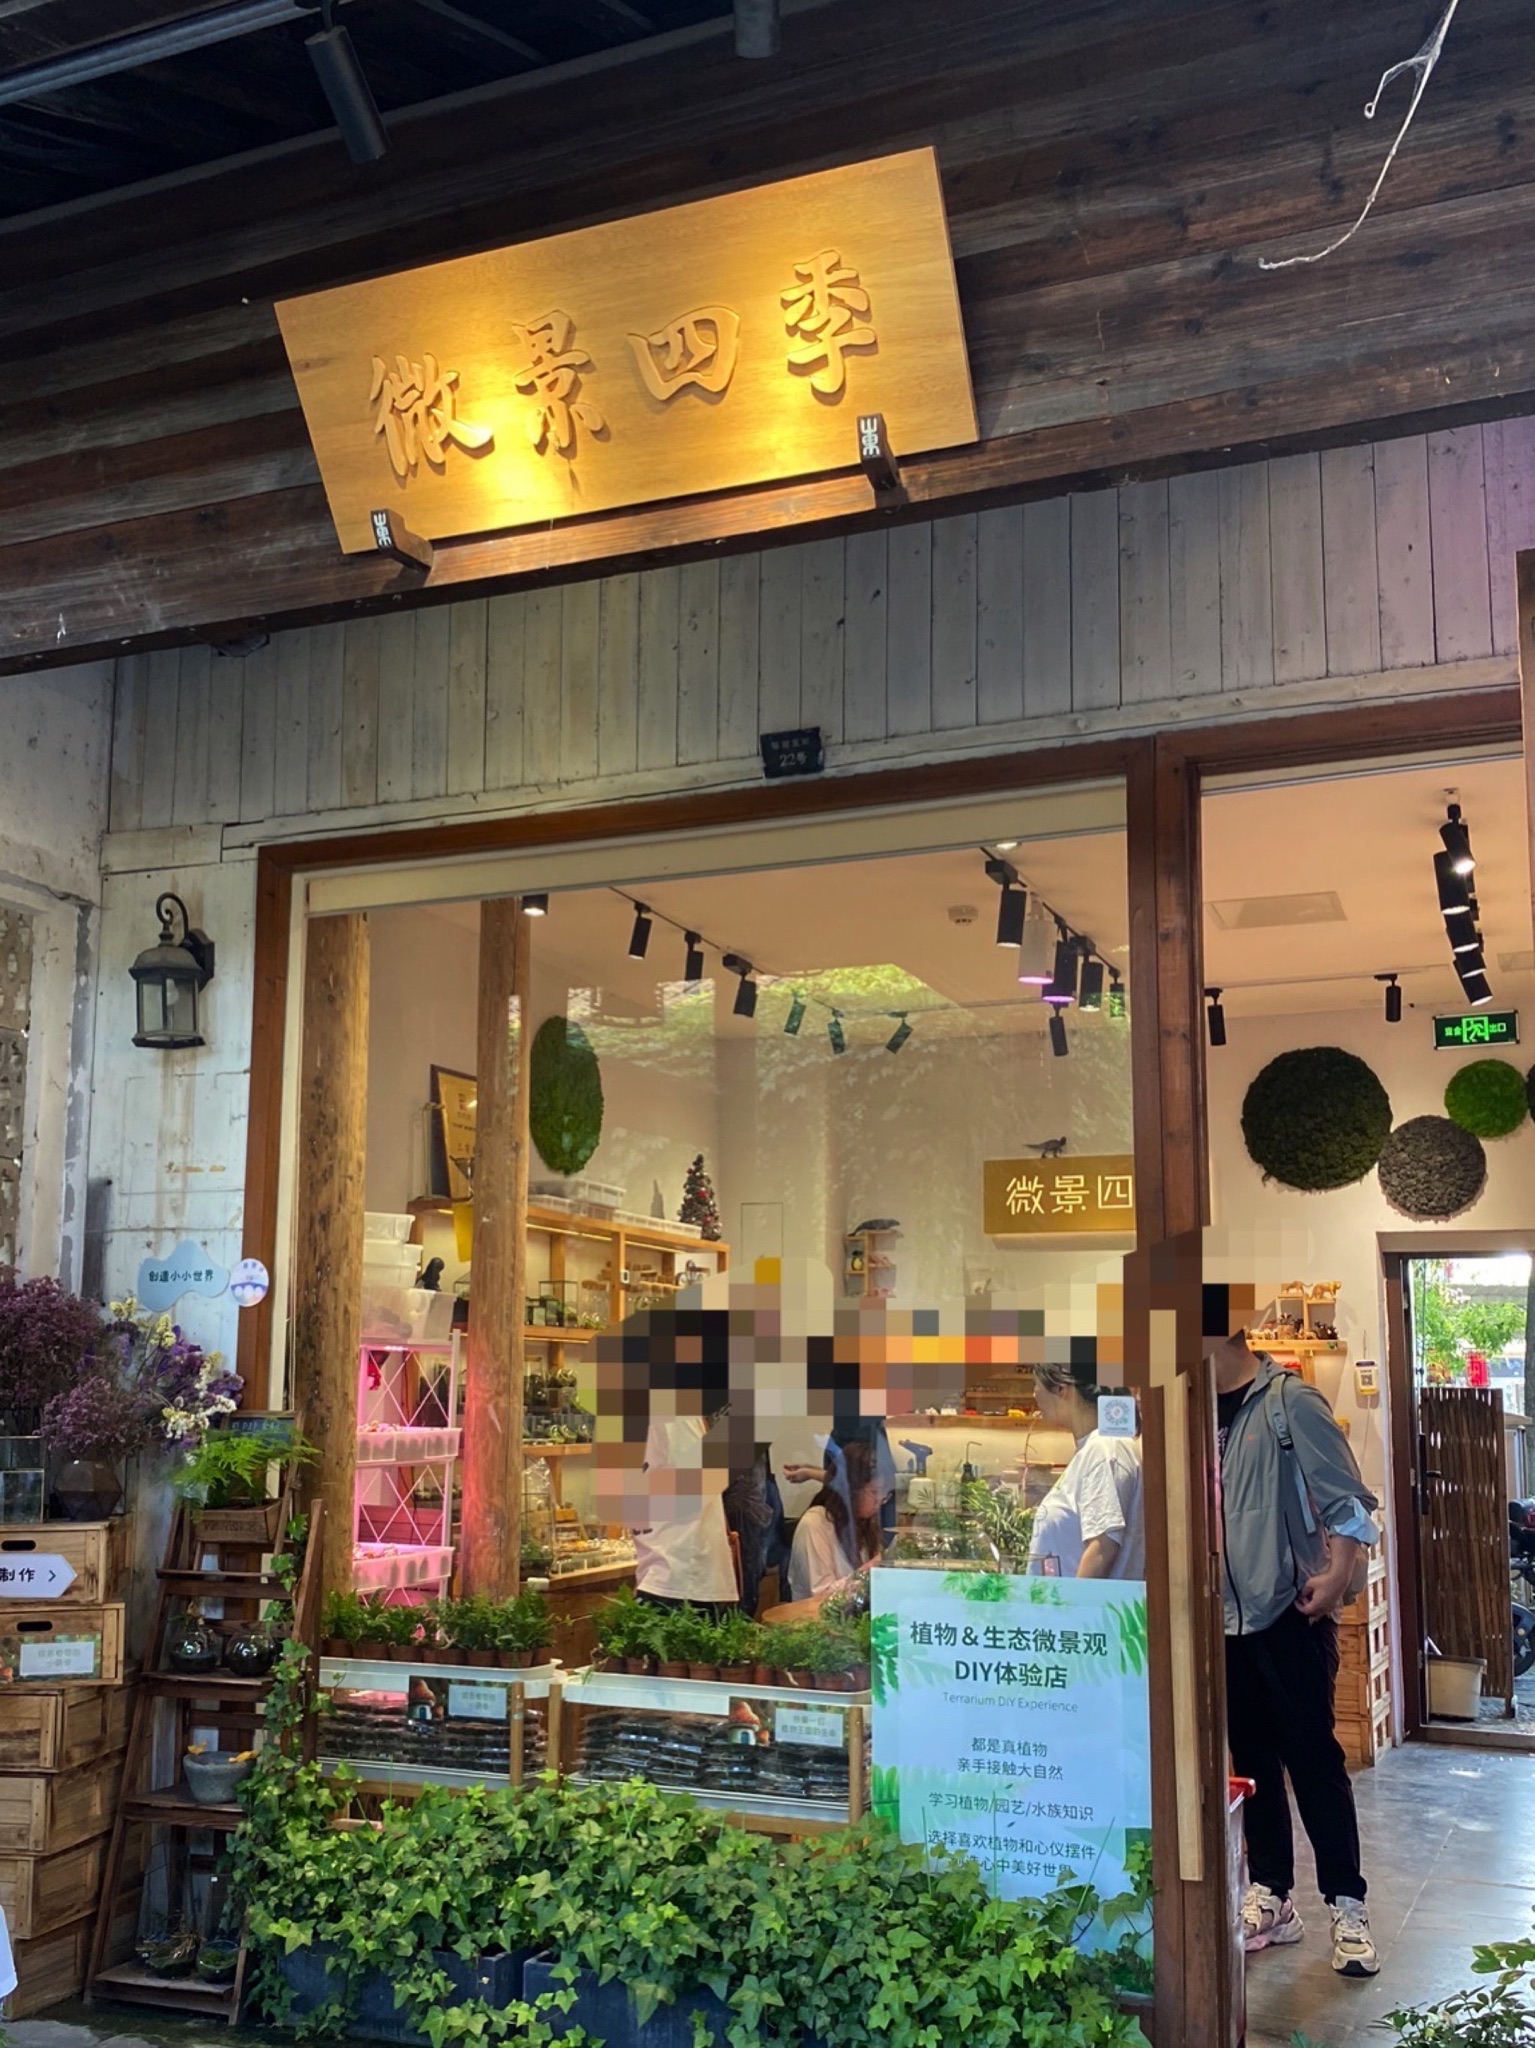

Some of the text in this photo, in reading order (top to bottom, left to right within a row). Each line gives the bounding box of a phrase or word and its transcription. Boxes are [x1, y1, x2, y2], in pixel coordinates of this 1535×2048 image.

[370, 248, 878, 478] 微景四季
[1489, 1022, 1507, 1033] 出口
[1006, 1174, 1134, 1215] 微景四
[148, 1268, 214, 1282] 创造小小世界
[0, 1567, 36, 1583] 制作
[955, 1660, 1068, 1690] DIY体验店
[942, 1691, 996, 1707] Terrarium
[1018, 1697, 1079, 1713] Experience
[971, 1737, 1048, 1758] 都是真植物
[957, 1757, 1064, 1781] 亲手接触大自然
[928, 1792, 1094, 1822] 学习植物/园艺/水族知识
[927, 1829, 1097, 1861] 选择喜欢植物和心仪摆件
